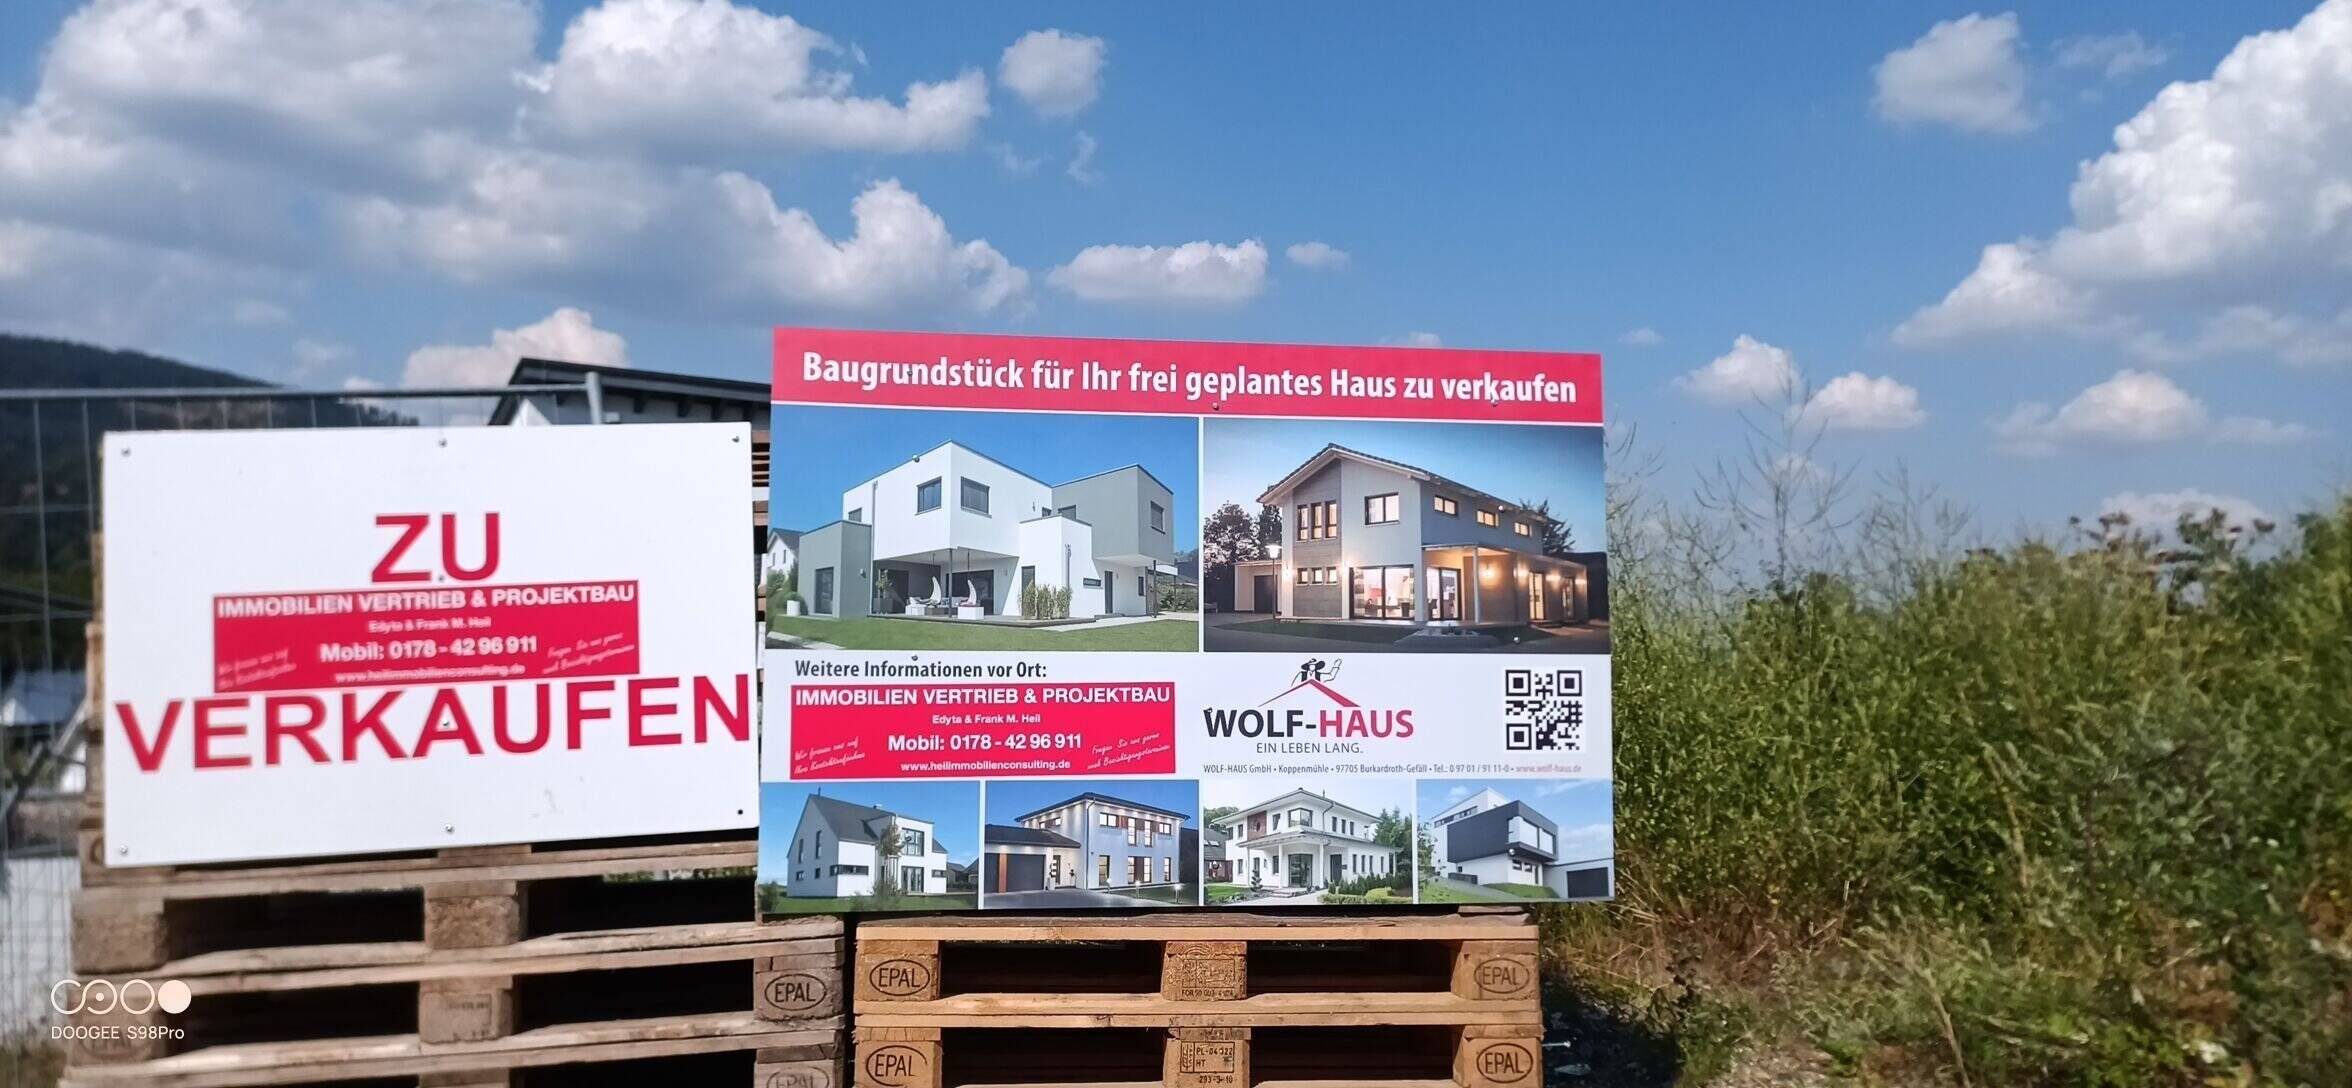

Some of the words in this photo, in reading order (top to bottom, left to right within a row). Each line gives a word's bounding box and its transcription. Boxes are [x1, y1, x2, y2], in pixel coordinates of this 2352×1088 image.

[803, 351, 1024, 391] Baugrundstück
[1031, 359, 1074, 390] für
[1081, 362, 1120, 391] Ihr
[1128, 362, 1178, 393] frei
[1185, 365, 1323, 403] geplantes
[1330, 368, 1397, 399] Haus
[1403, 376, 1434, 400] zu
[1440, 372, 1577, 404] verkaufen
[371, 512, 501, 583] ZU
[218, 595, 354, 619] IMMOBILIEN
[357, 590, 467, 613] VERTRIEB
[470, 588, 487, 608] &
[490, 584, 636, 607] PROJEKTBAU
[320, 643, 385, 663] Mobil:
[388, 638, 437, 660] 0178
[449, 637, 476, 657] 42
[505, 634, 538, 654] 911
[795, 660, 860, 677] Weitere
[864, 661, 982, 678] Informationen
[987, 664, 1013, 678] vor
[1016, 661, 1047, 678] Ort:
[795, 689, 918, 706] IMMOBILIEN
[922, 688, 1019, 705] VERTRIEB
[1023, 688, 1038, 704] &
[1042, 686, 1171, 703] PROJEKTBAU
[115, 672, 751, 772] VERKAUFEN
[932, 715, 963, 726] Edyta
[964, 715, 973, 724] &
[974, 714, 1004, 724] Frank
[1006, 714, 1019, 723] M.
[1021, 713, 1041, 723] Heil
[1203, 707, 1414, 738] WOLF-HAUS
[888, 735, 945, 751] Mobil:
[950, 735, 992, 750] 0178
[1004, 734, 1027, 750] 42
[1029, 734, 1051, 749] 96
[1054, 734, 1081, 749] 911
[1256, 742, 1277, 753] EIN
[1281, 742, 1321, 754] LEBEN
[901, 760, 1071, 771] www.heilimmobilienconsulting.de
[1203, 764, 1248, 774] WOLF-HAUS
[1250, 764, 1272, 773] GmbH
[1279, 764, 1329, 775] Koppenmühle
[1336, 765, 1358, 773] 97705
[878, 967, 921, 988] EPAL
[1482, 966, 1519, 985] EPAL
[773, 983, 816, 1003] EPAL
[874, 1054, 916, 1077] EPAL
[1485, 1052, 1525, 1074] EPAL
